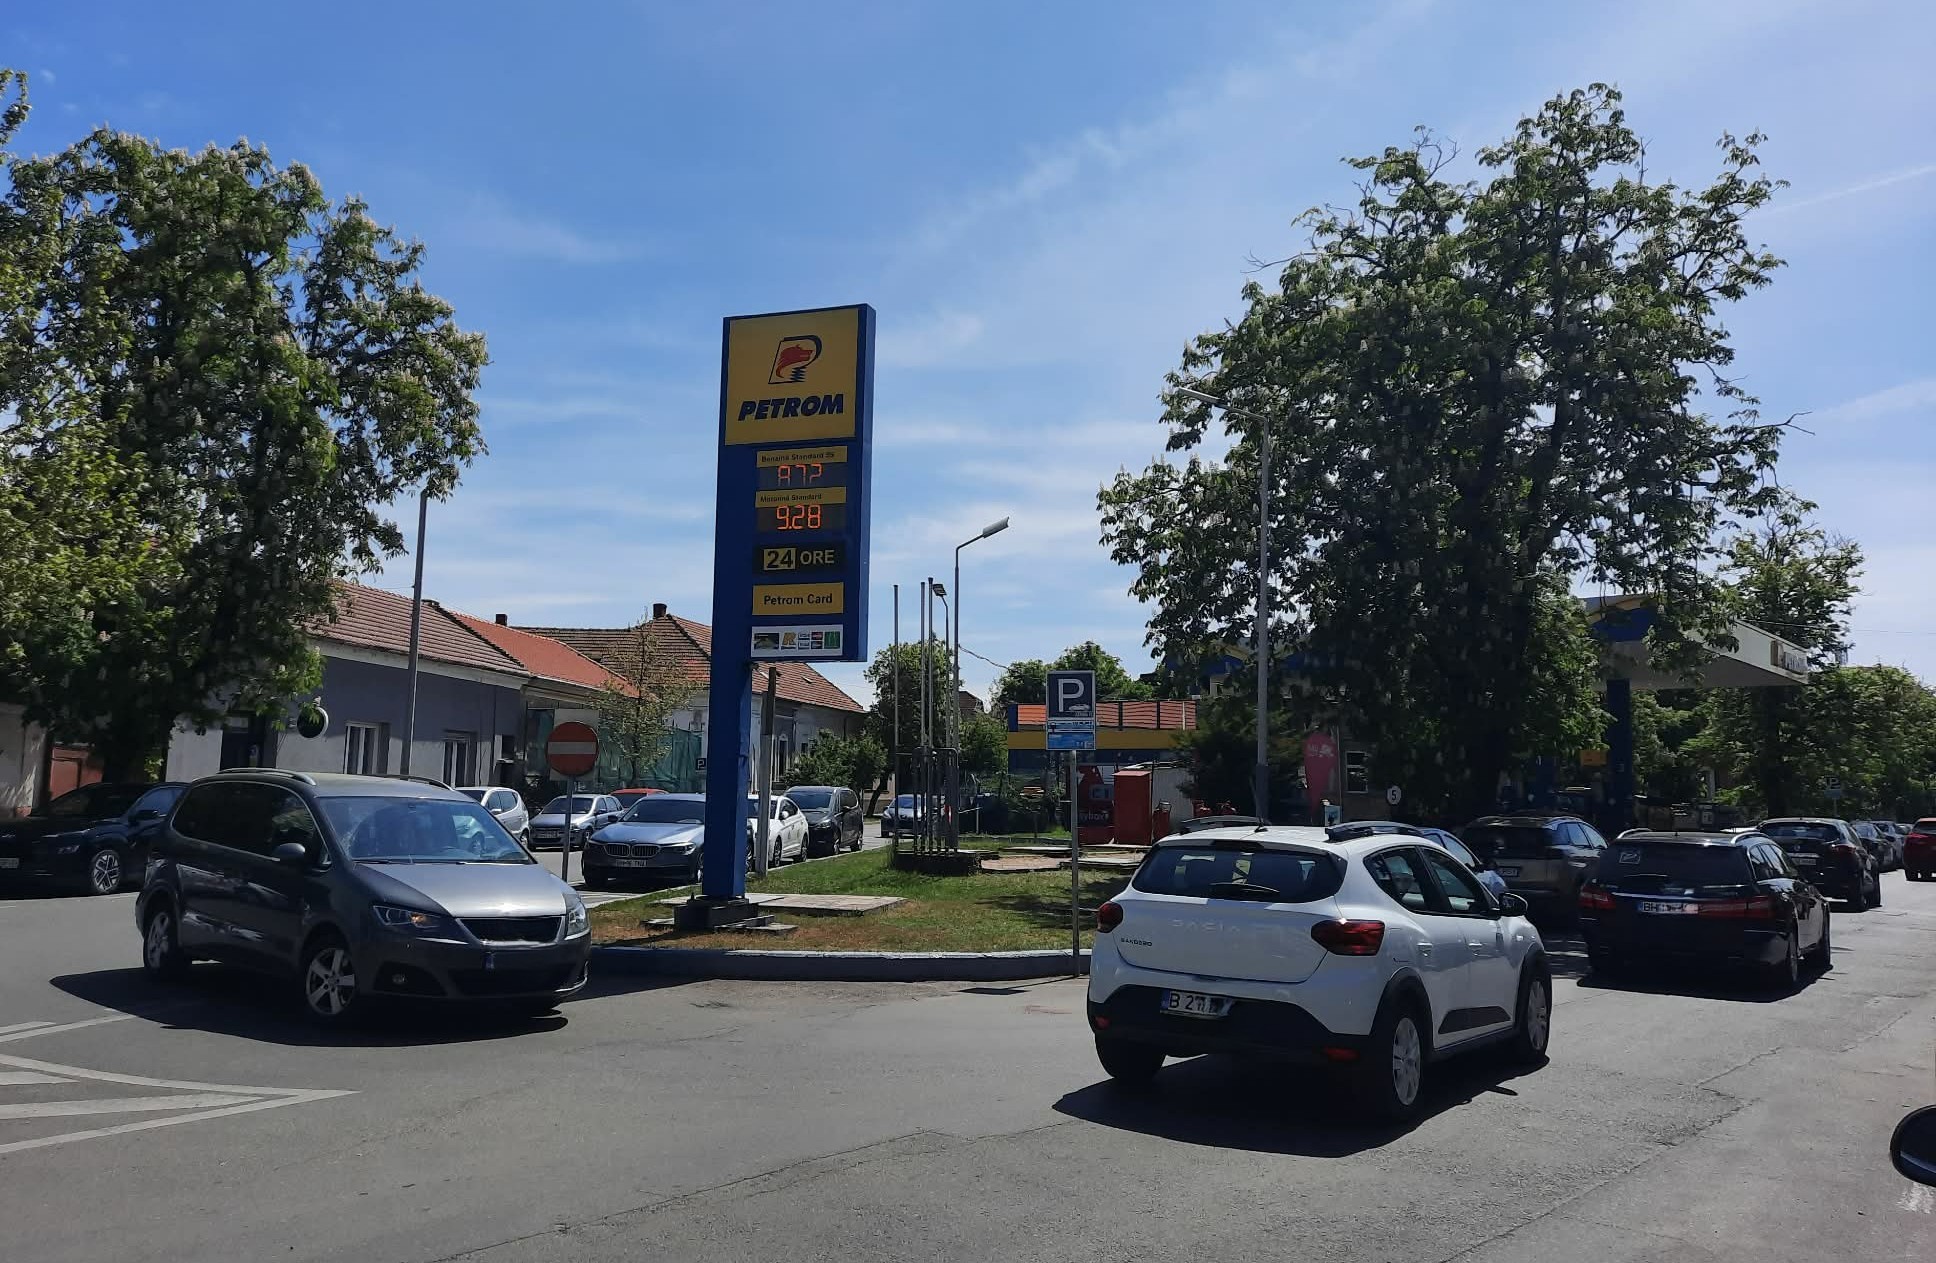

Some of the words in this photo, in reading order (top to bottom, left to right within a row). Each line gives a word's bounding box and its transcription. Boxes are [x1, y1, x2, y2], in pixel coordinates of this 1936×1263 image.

[738, 394, 844, 421] PETROM
[791, 493, 822, 501] Standard
[776, 504, 821, 530] 9.28
[766, 550, 794, 568] 24
[800, 549, 835, 565] ORE
[763, 595, 804, 605] Petrom
[807, 593, 833, 604] Card
[1058, 678, 1085, 713] P
[1391, 789, 1398, 801] 5
[1121, 938, 1152, 947] SANDERO
[1169, 993, 1180, 1009] B
